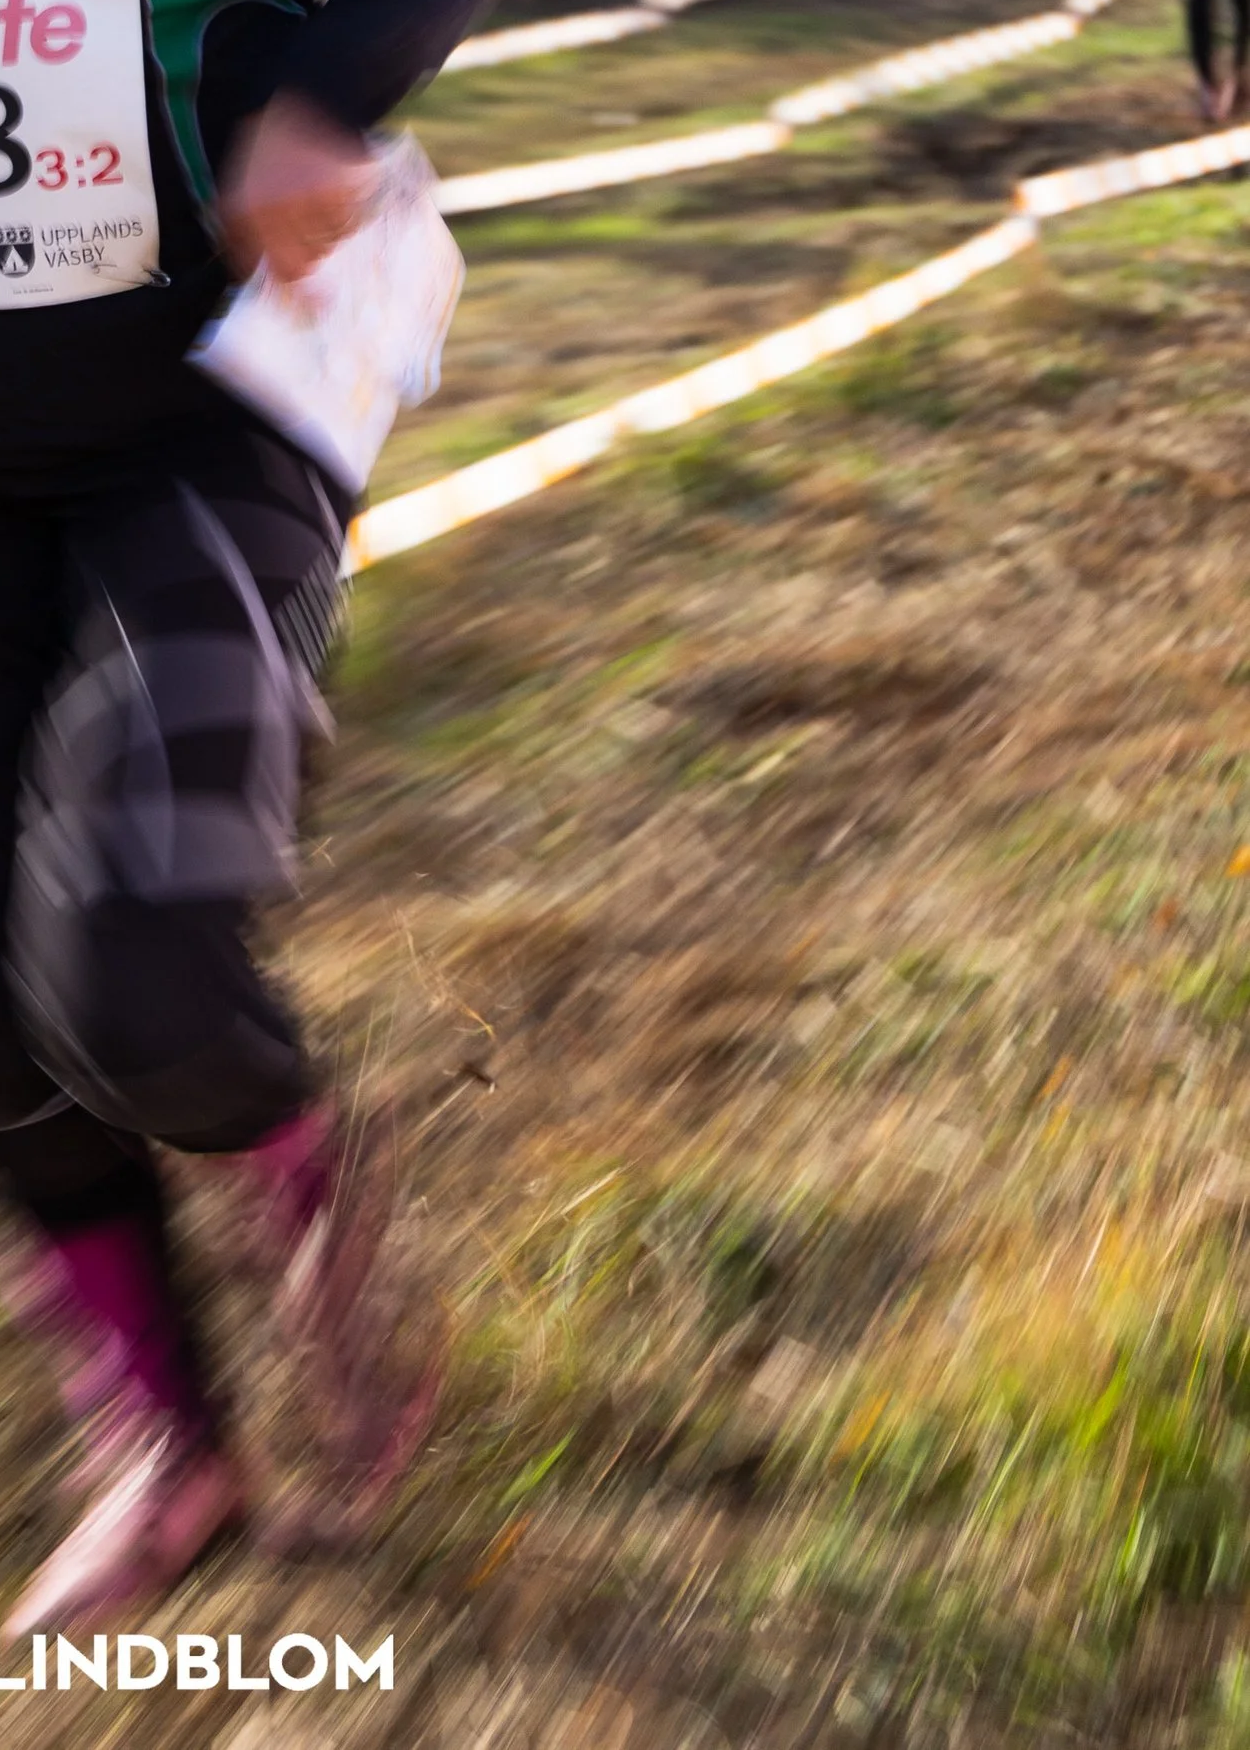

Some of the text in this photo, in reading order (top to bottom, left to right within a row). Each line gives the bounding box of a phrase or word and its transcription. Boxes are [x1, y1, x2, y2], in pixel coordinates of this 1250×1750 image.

[33, 140, 124, 191] 3:2
[40, 217, 145, 247] UPPLANDS
[43, 246, 106, 268] VÄSBY
